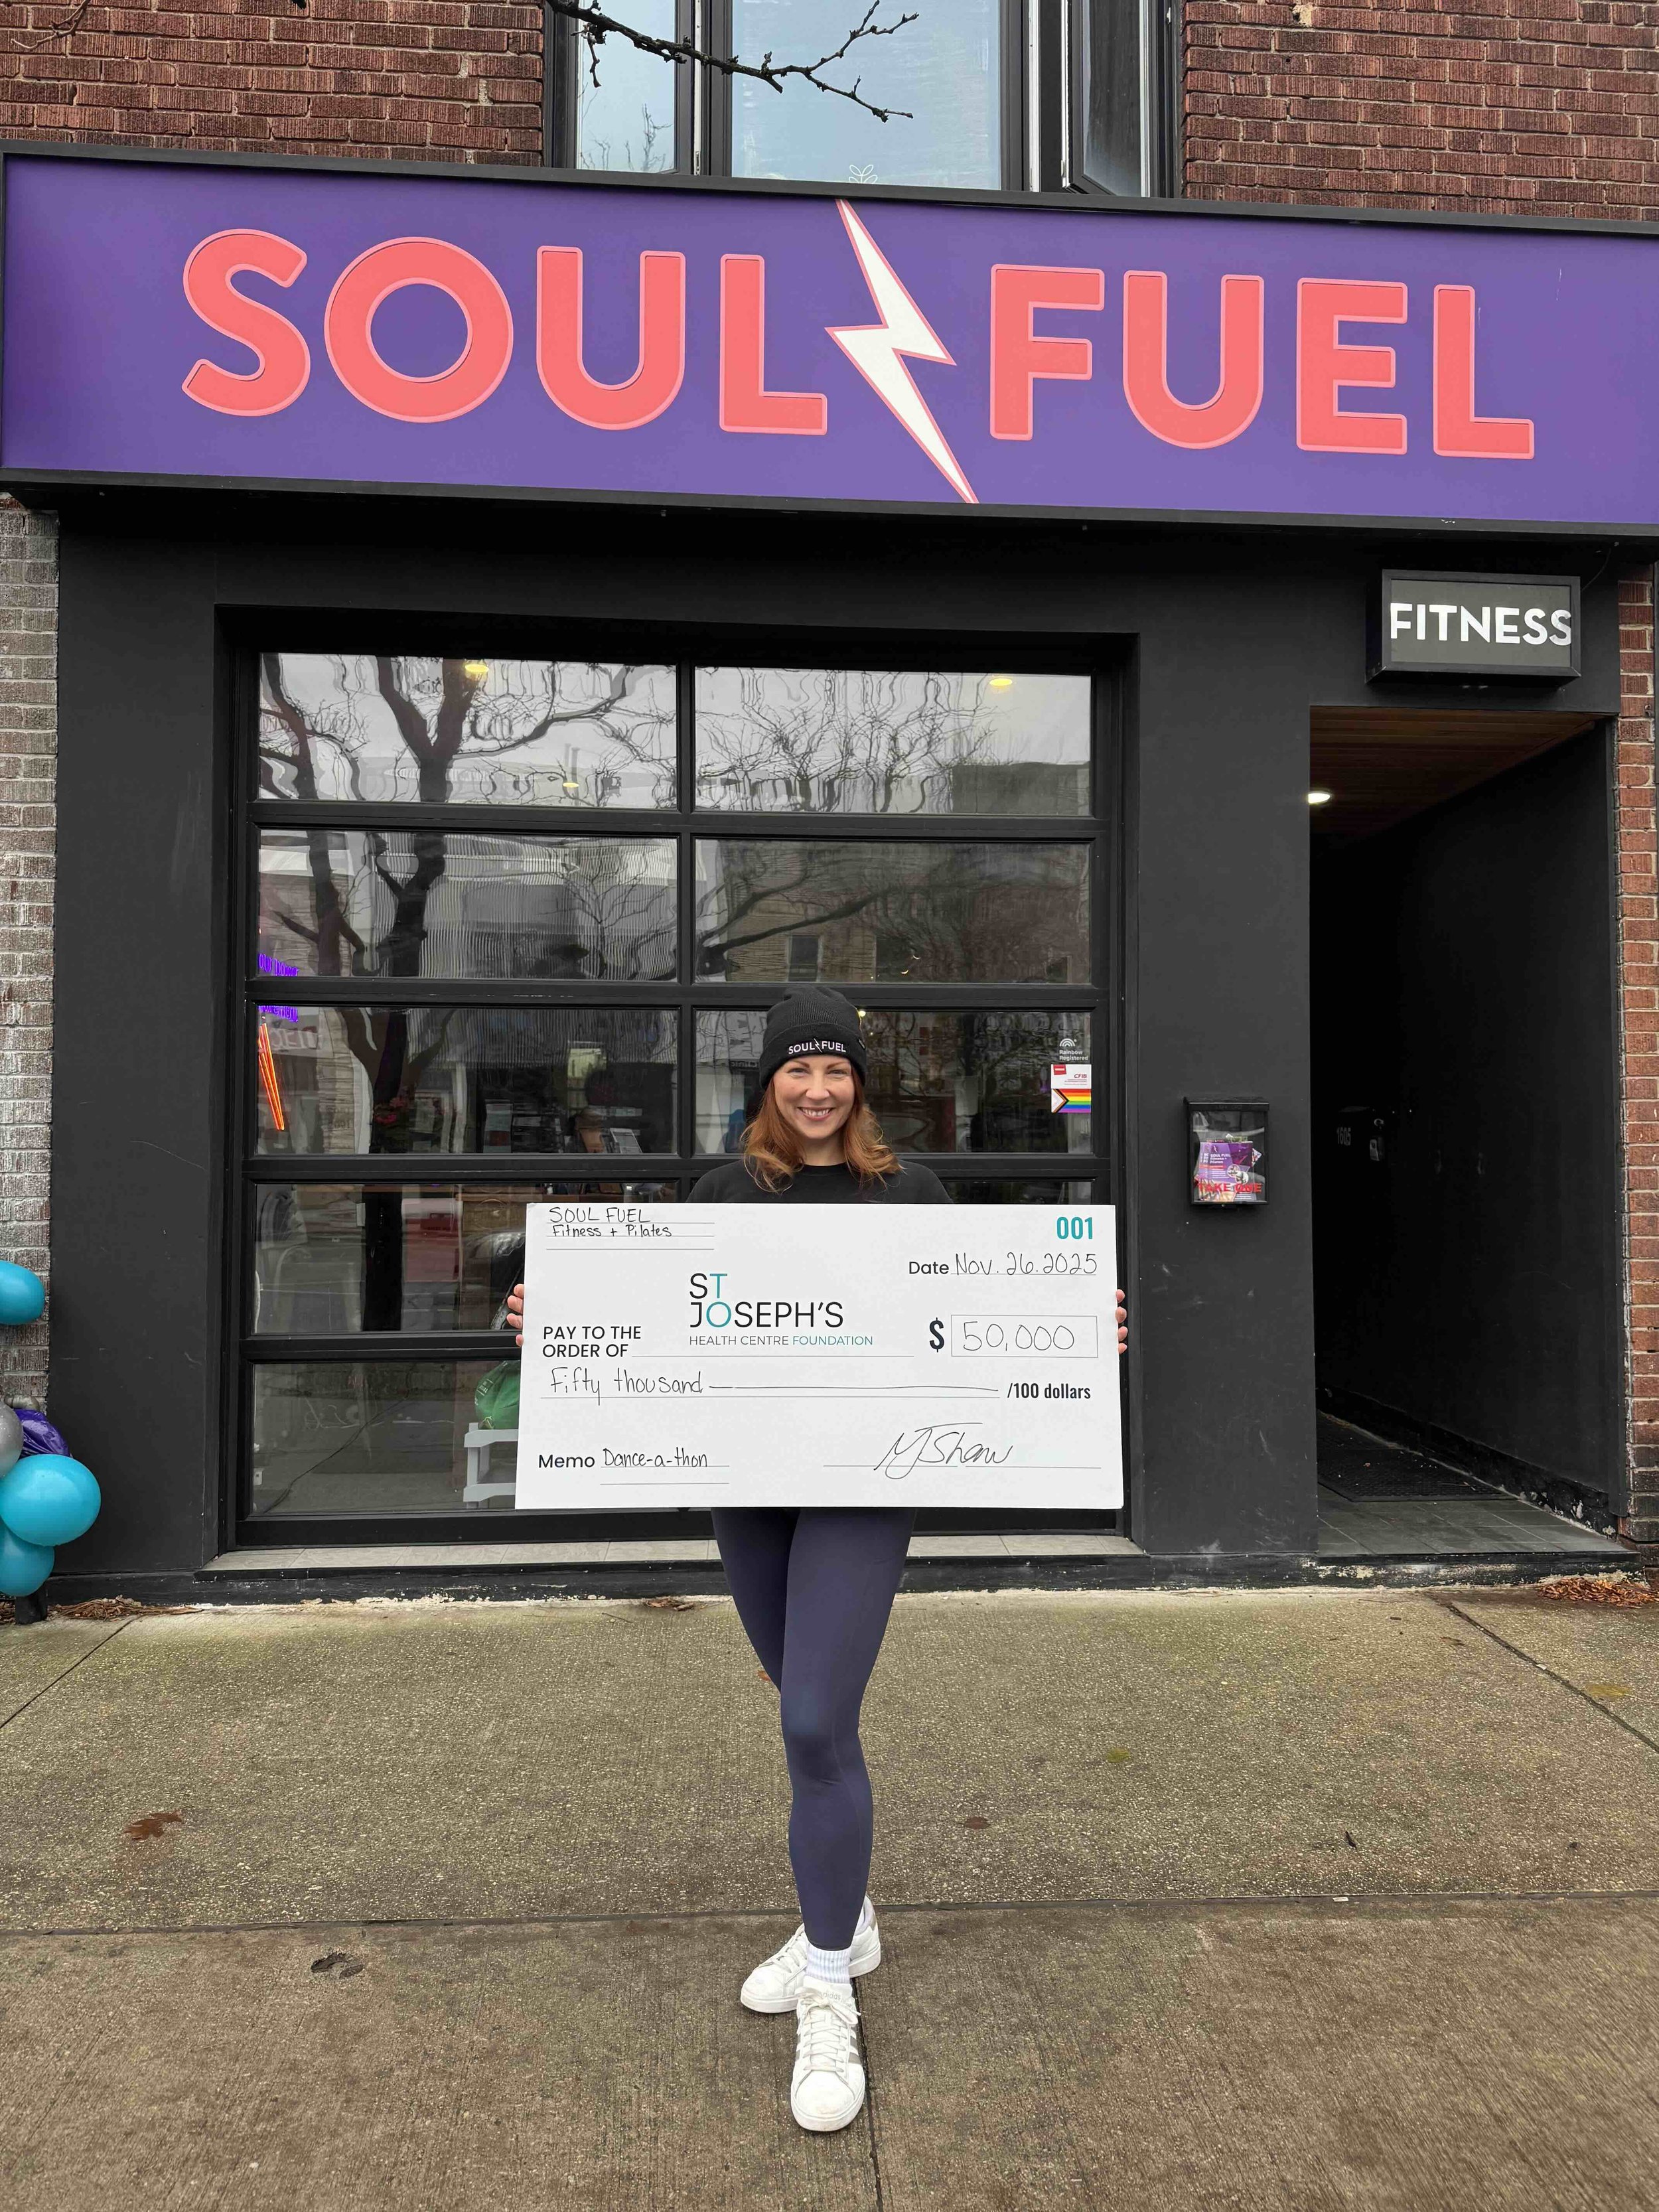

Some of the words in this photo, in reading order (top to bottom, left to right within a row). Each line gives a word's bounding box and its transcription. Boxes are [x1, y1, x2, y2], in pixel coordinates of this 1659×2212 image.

[182, 228, 828, 435] SOUL
[990, 263, 1534, 459] FUEL
[1390, 603, 1571, 646] FITNESS
[788, 1042, 815, 1055] SOUL
[822, 1041, 846, 1053] FUEL
[1336, 1126, 1351, 1145] 1605
[1198, 1183, 1231, 1192] TAKE
[1235, 1183, 1262, 1193] ONE
[549, 1207, 600, 1223] SOUL
[606, 1208, 651, 1223] FUEL
[552, 1224, 602, 1238] Fitness
[611, 1228, 618, 1237] +
[626, 1224, 672, 1238] Pilates
[1056, 1217, 1094, 1240] 001
[908, 1261, 950, 1275] Date
[689, 1272, 728, 1299] ST
[689, 1301, 843, 1328] JOSEPH'S
[543, 1326, 577, 1339] PAY
[581, 1326, 605, 1340] TO
[611, 1326, 642, 1339] THE
[689, 1335, 737, 1345] HEALTH
[740, 1335, 789, 1345] CENTRE
[793, 1335, 873, 1346] FOUNDATION
[928, 1317, 945, 1353] $
[963, 1321, 1075, 1351] 50,000
[542, 1344, 601, 1358] ORDER
[606, 1344, 629, 1358] OF
[550, 1366, 601, 1406] Fifty
[614, 1367, 703, 1394] thousand
[1007, 1382, 1039, 1398] /100
[1044, 1383, 1091, 1398] dollars
[538, 1454, 595, 1468] Memo
[603, 1447, 708, 1468] Dance-a-thon
